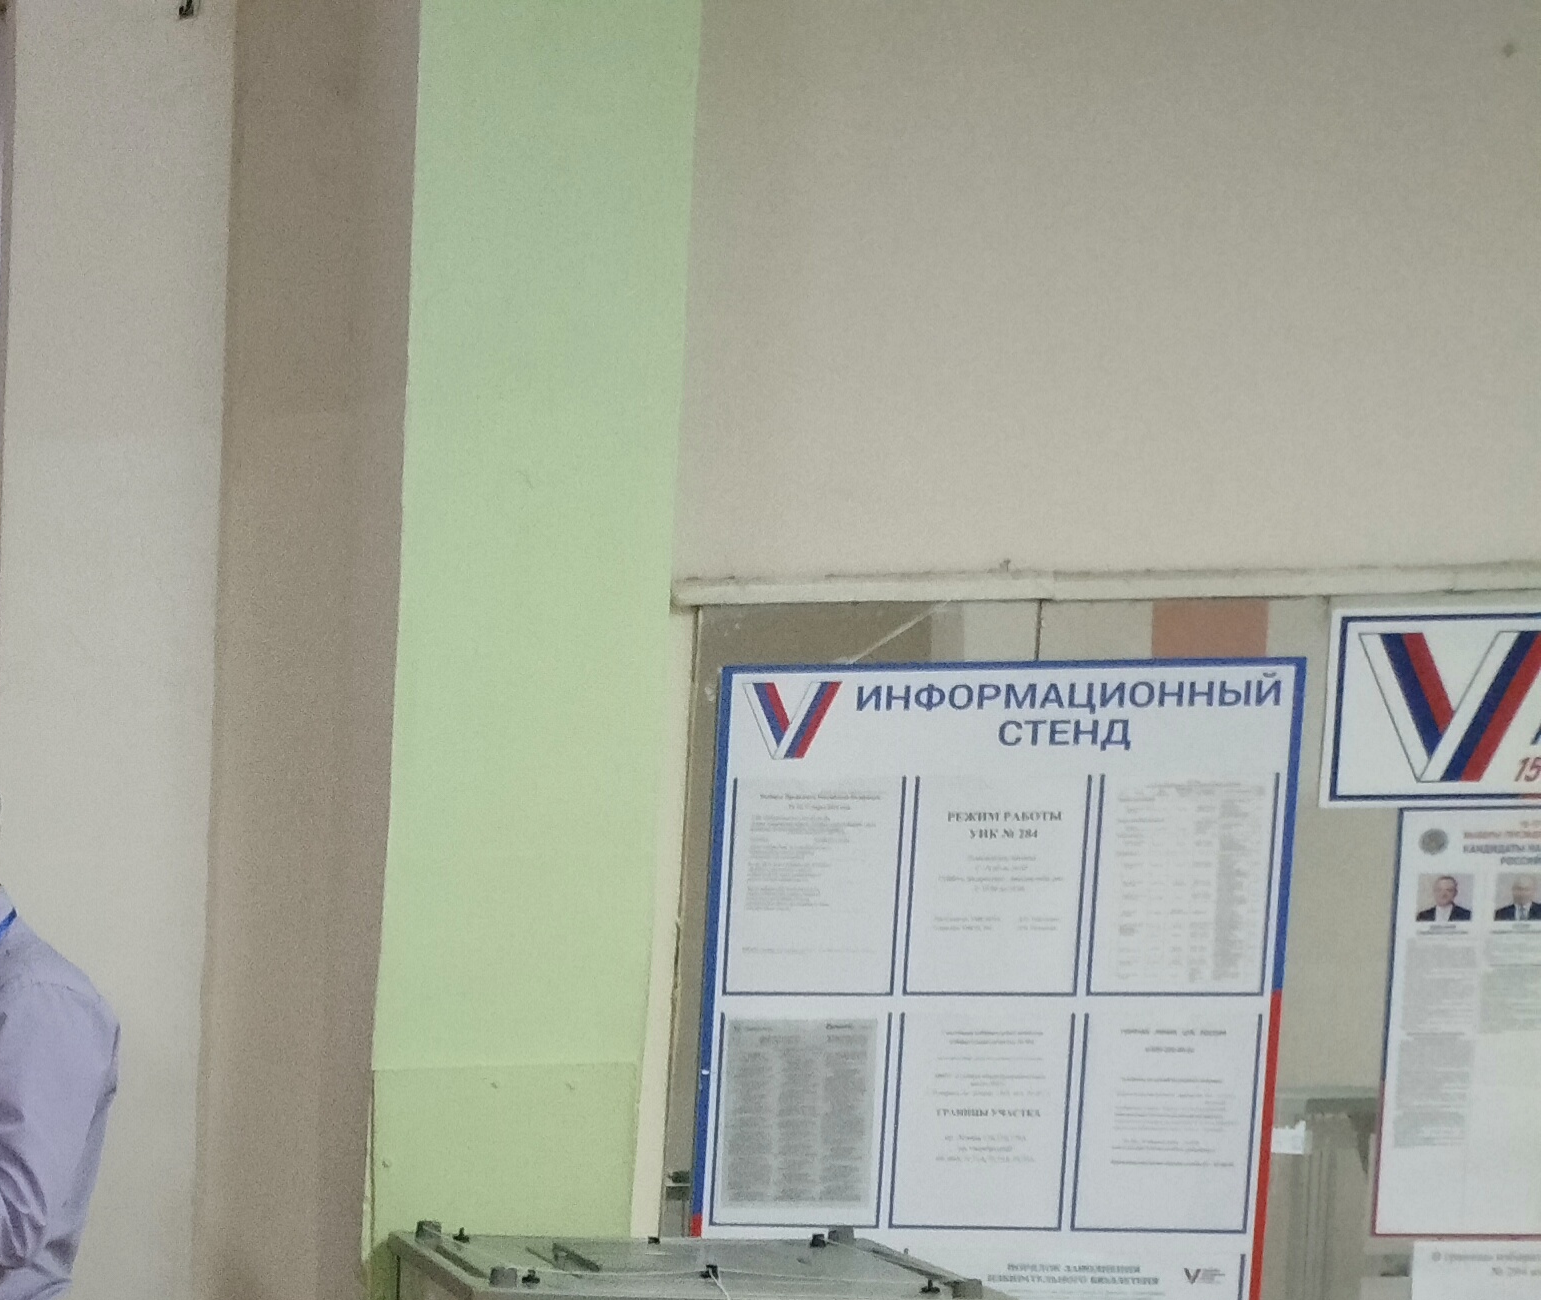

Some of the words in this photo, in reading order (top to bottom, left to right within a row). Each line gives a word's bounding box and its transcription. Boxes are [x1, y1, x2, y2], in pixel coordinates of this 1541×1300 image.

[855, 671, 1283, 714] ИНФОРМАЦИОННЫЙ
[997, 717, 1132, 750] СТЕНД
[947, 811, 999, 822] РЕЖИМ
[1004, 811, 1062, 821] РАБОТЫ
[1019, 828, 1038, 839] 284
